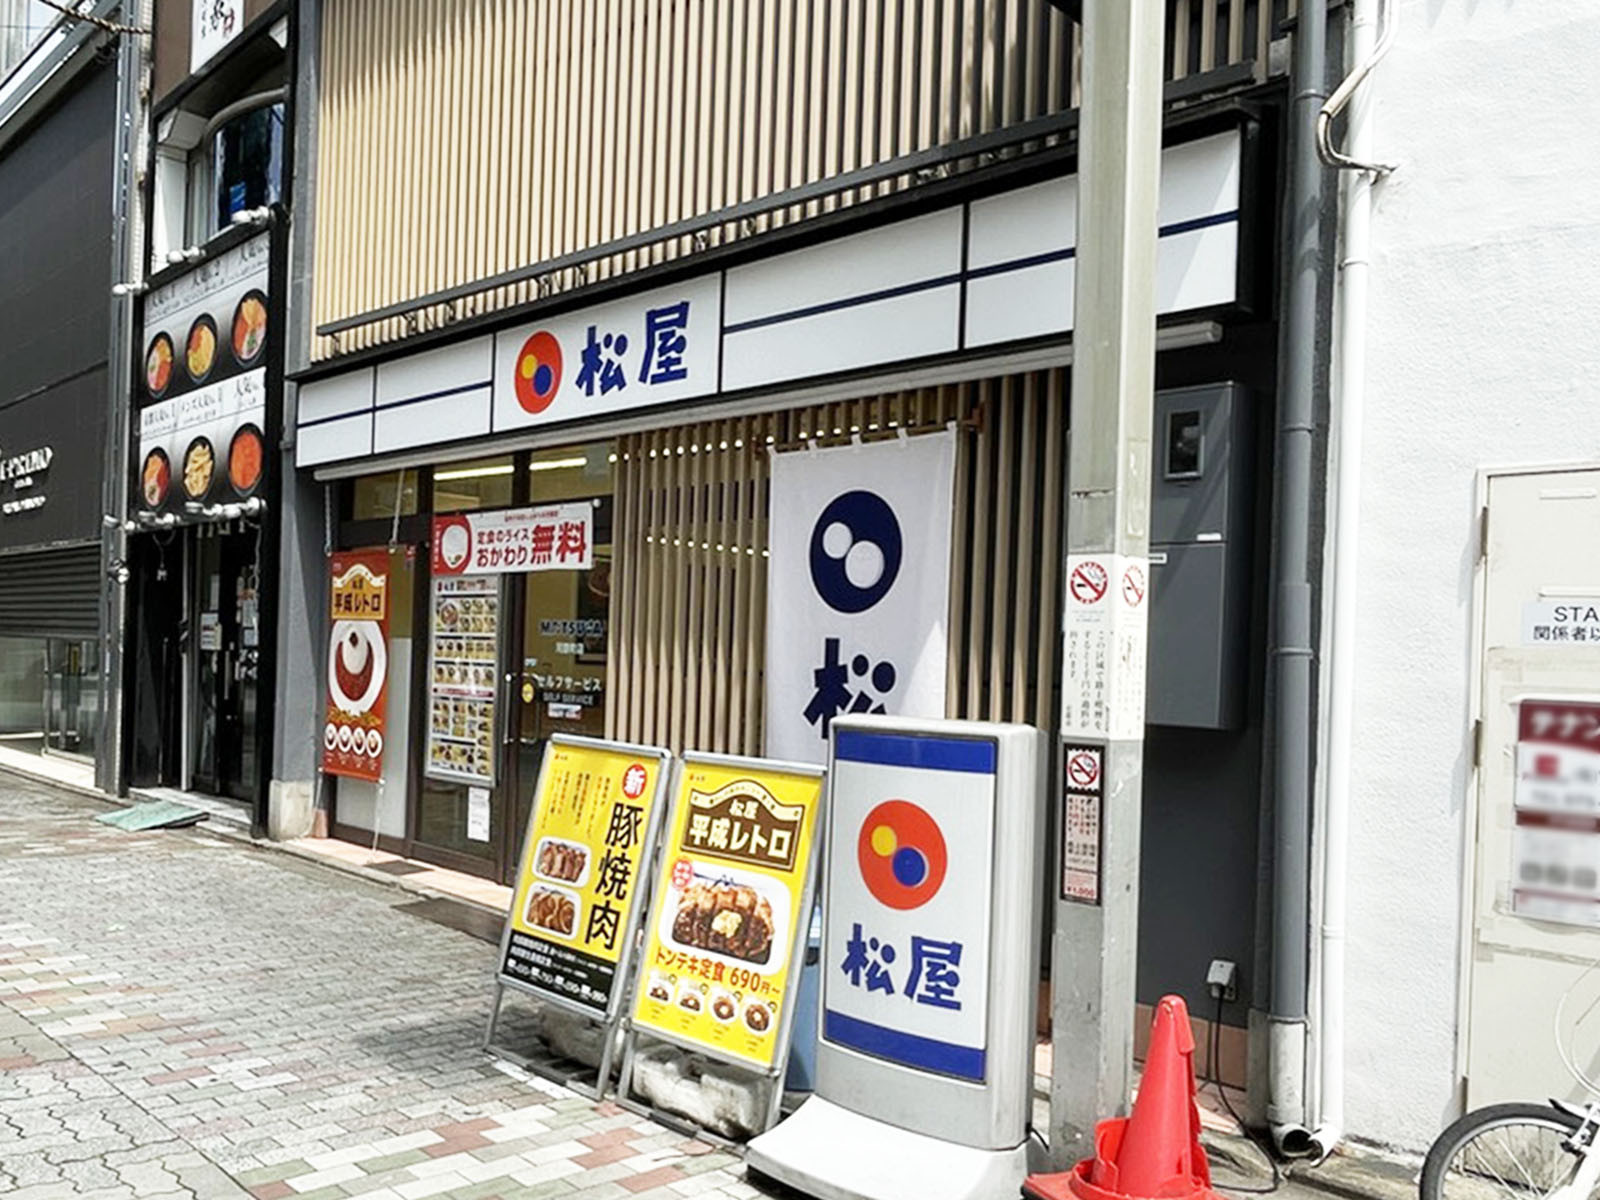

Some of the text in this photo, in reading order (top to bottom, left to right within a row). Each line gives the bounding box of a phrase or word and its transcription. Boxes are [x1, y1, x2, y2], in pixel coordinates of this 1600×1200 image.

[575, 301, 690, 397] 松屋
[477, 527, 531, 545] 定食のライス
[531, 520, 587, 565] 無料
[477, 544, 528, 568] おかわり
[1553, 605, 1600, 623] STA
[624, 766, 646, 796] 新
[729, 798, 760, 820] 松屋
[689, 813, 793, 859] 平成レトロ
[585, 802, 643, 950] 豚焼肉
[655, 947, 726, 983] トンテキ定食
[841, 922, 963, 1012] 松屋
